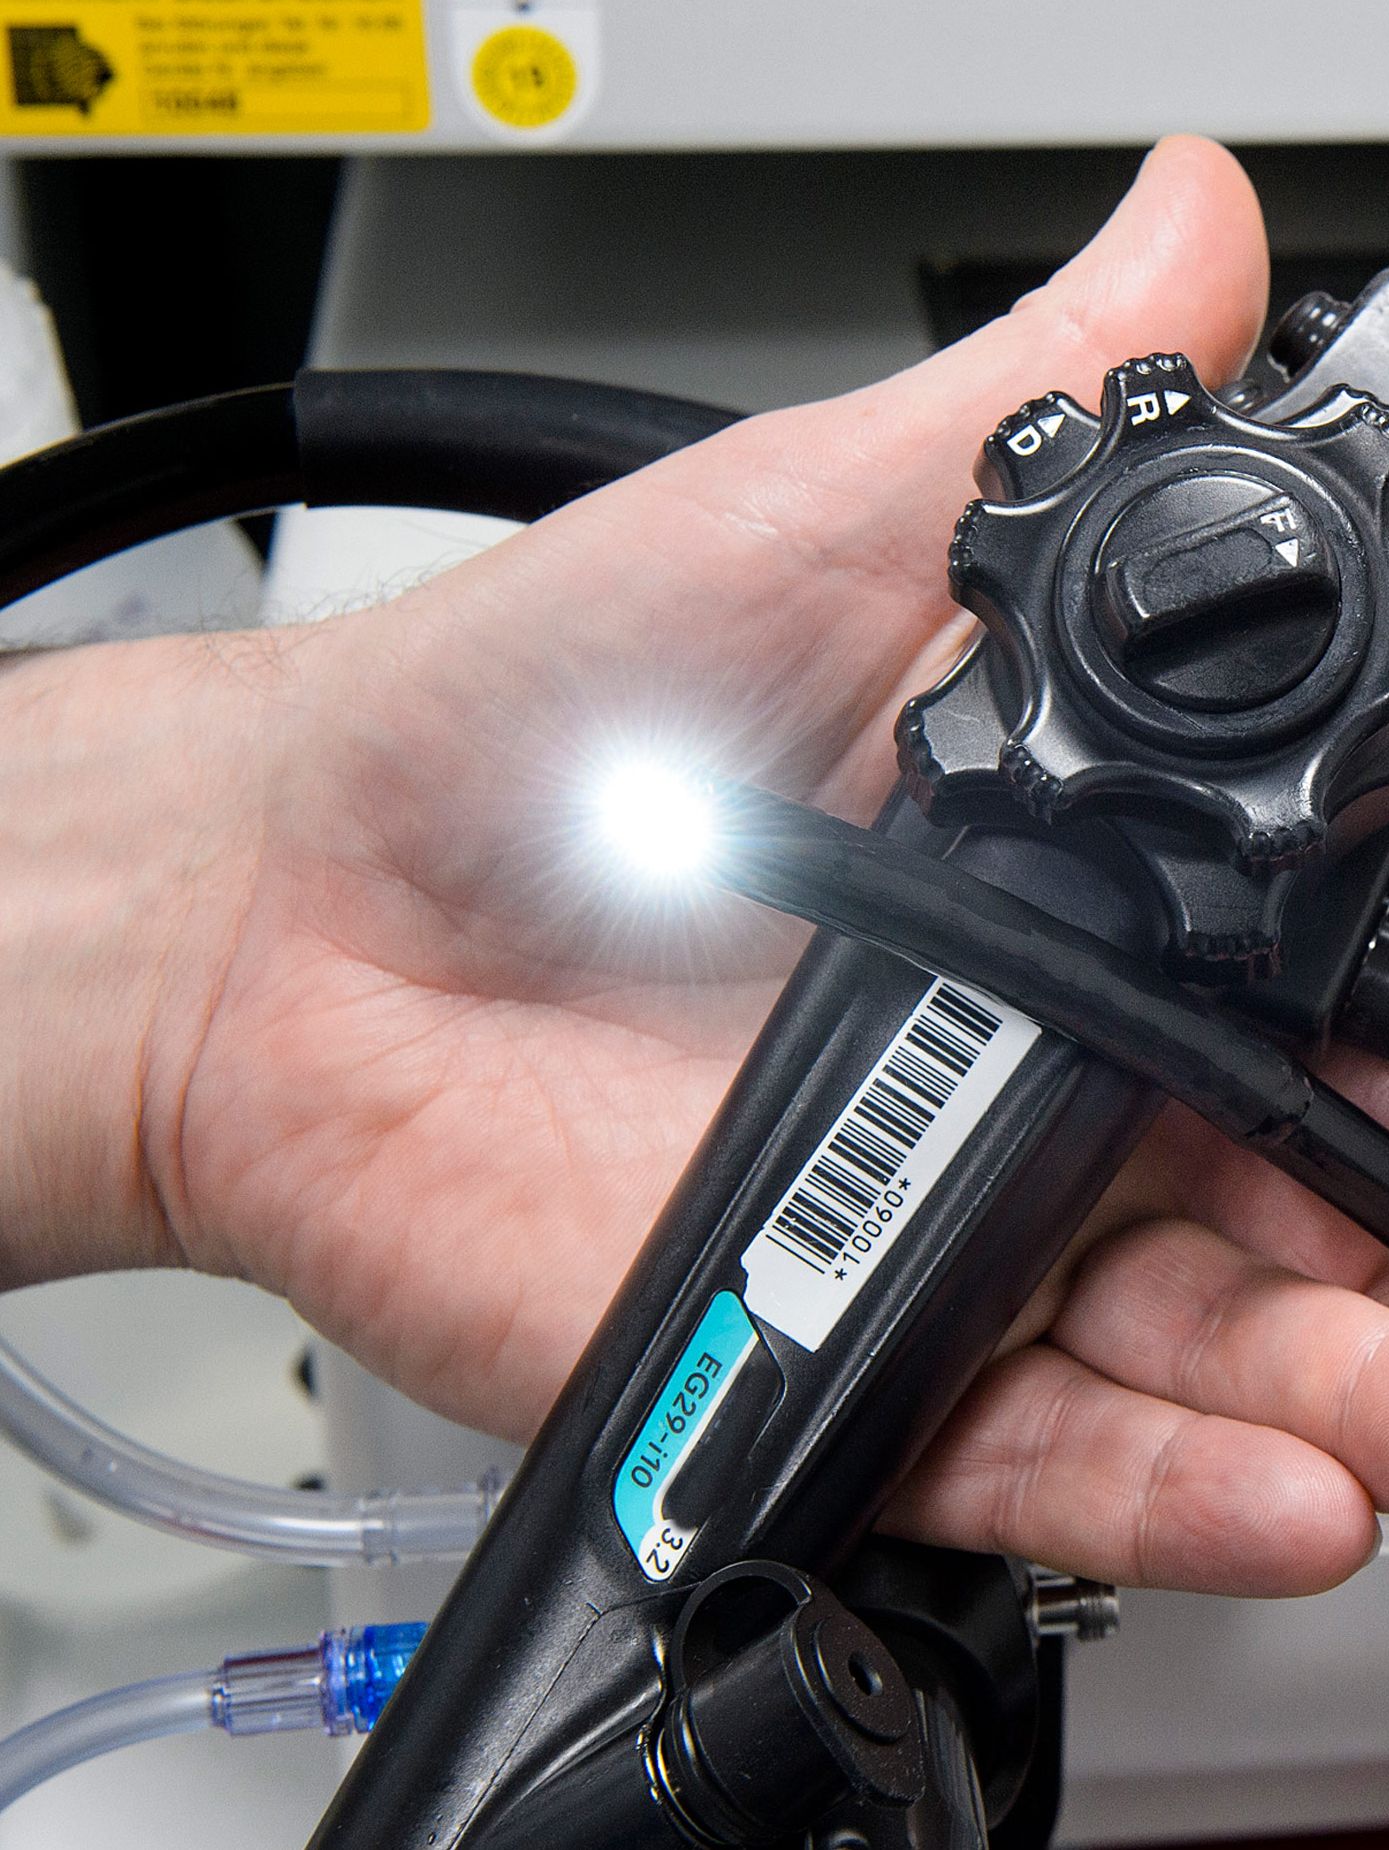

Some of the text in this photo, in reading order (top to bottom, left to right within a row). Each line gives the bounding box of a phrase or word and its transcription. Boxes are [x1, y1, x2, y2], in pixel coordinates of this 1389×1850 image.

[1127, 395, 1160, 425] R
[1007, 431, 1038, 458] D
[1260, 507, 1297, 533] F
[631, 1351, 723, 1489] EG29-i10
[646, 1526, 684, 1574] 3.2
